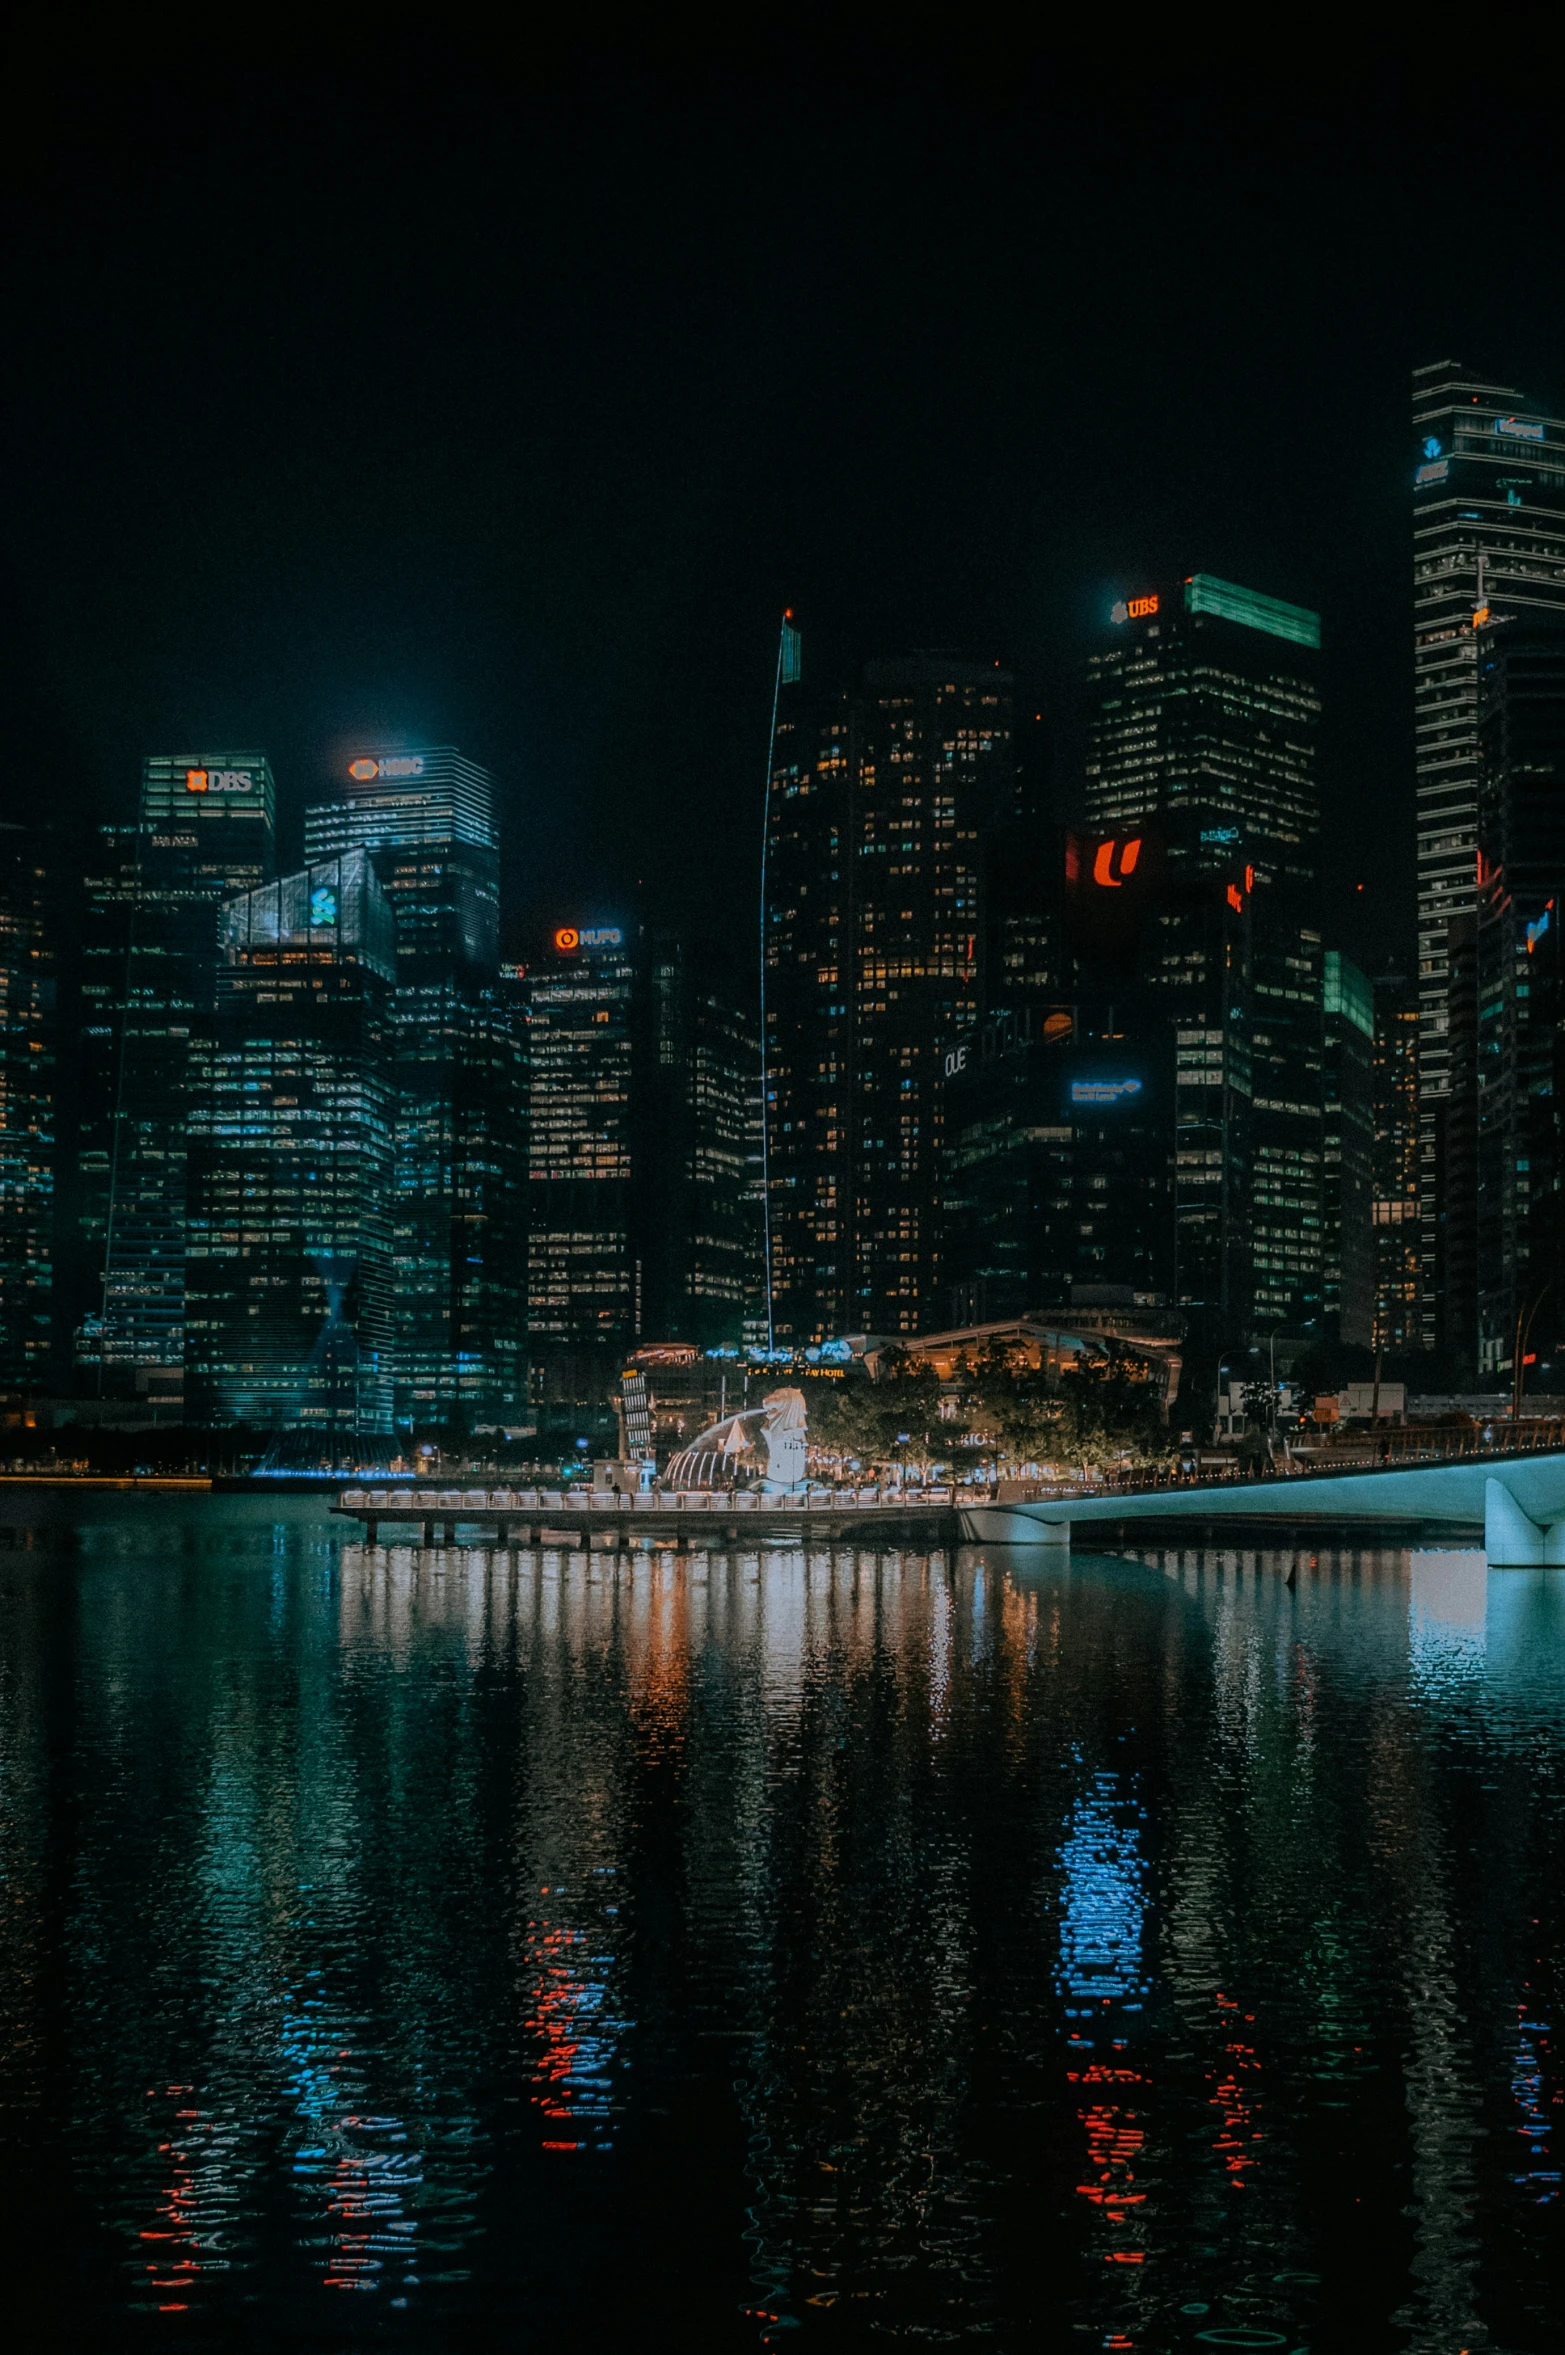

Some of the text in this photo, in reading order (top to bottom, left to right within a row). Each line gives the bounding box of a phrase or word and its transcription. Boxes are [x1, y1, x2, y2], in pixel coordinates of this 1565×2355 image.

[1127, 595, 1158, 618] UBS
[208, 771, 252, 792] DBS
[580, 928, 621, 945] MUFG
[945, 1047, 966, 1077] OUE
